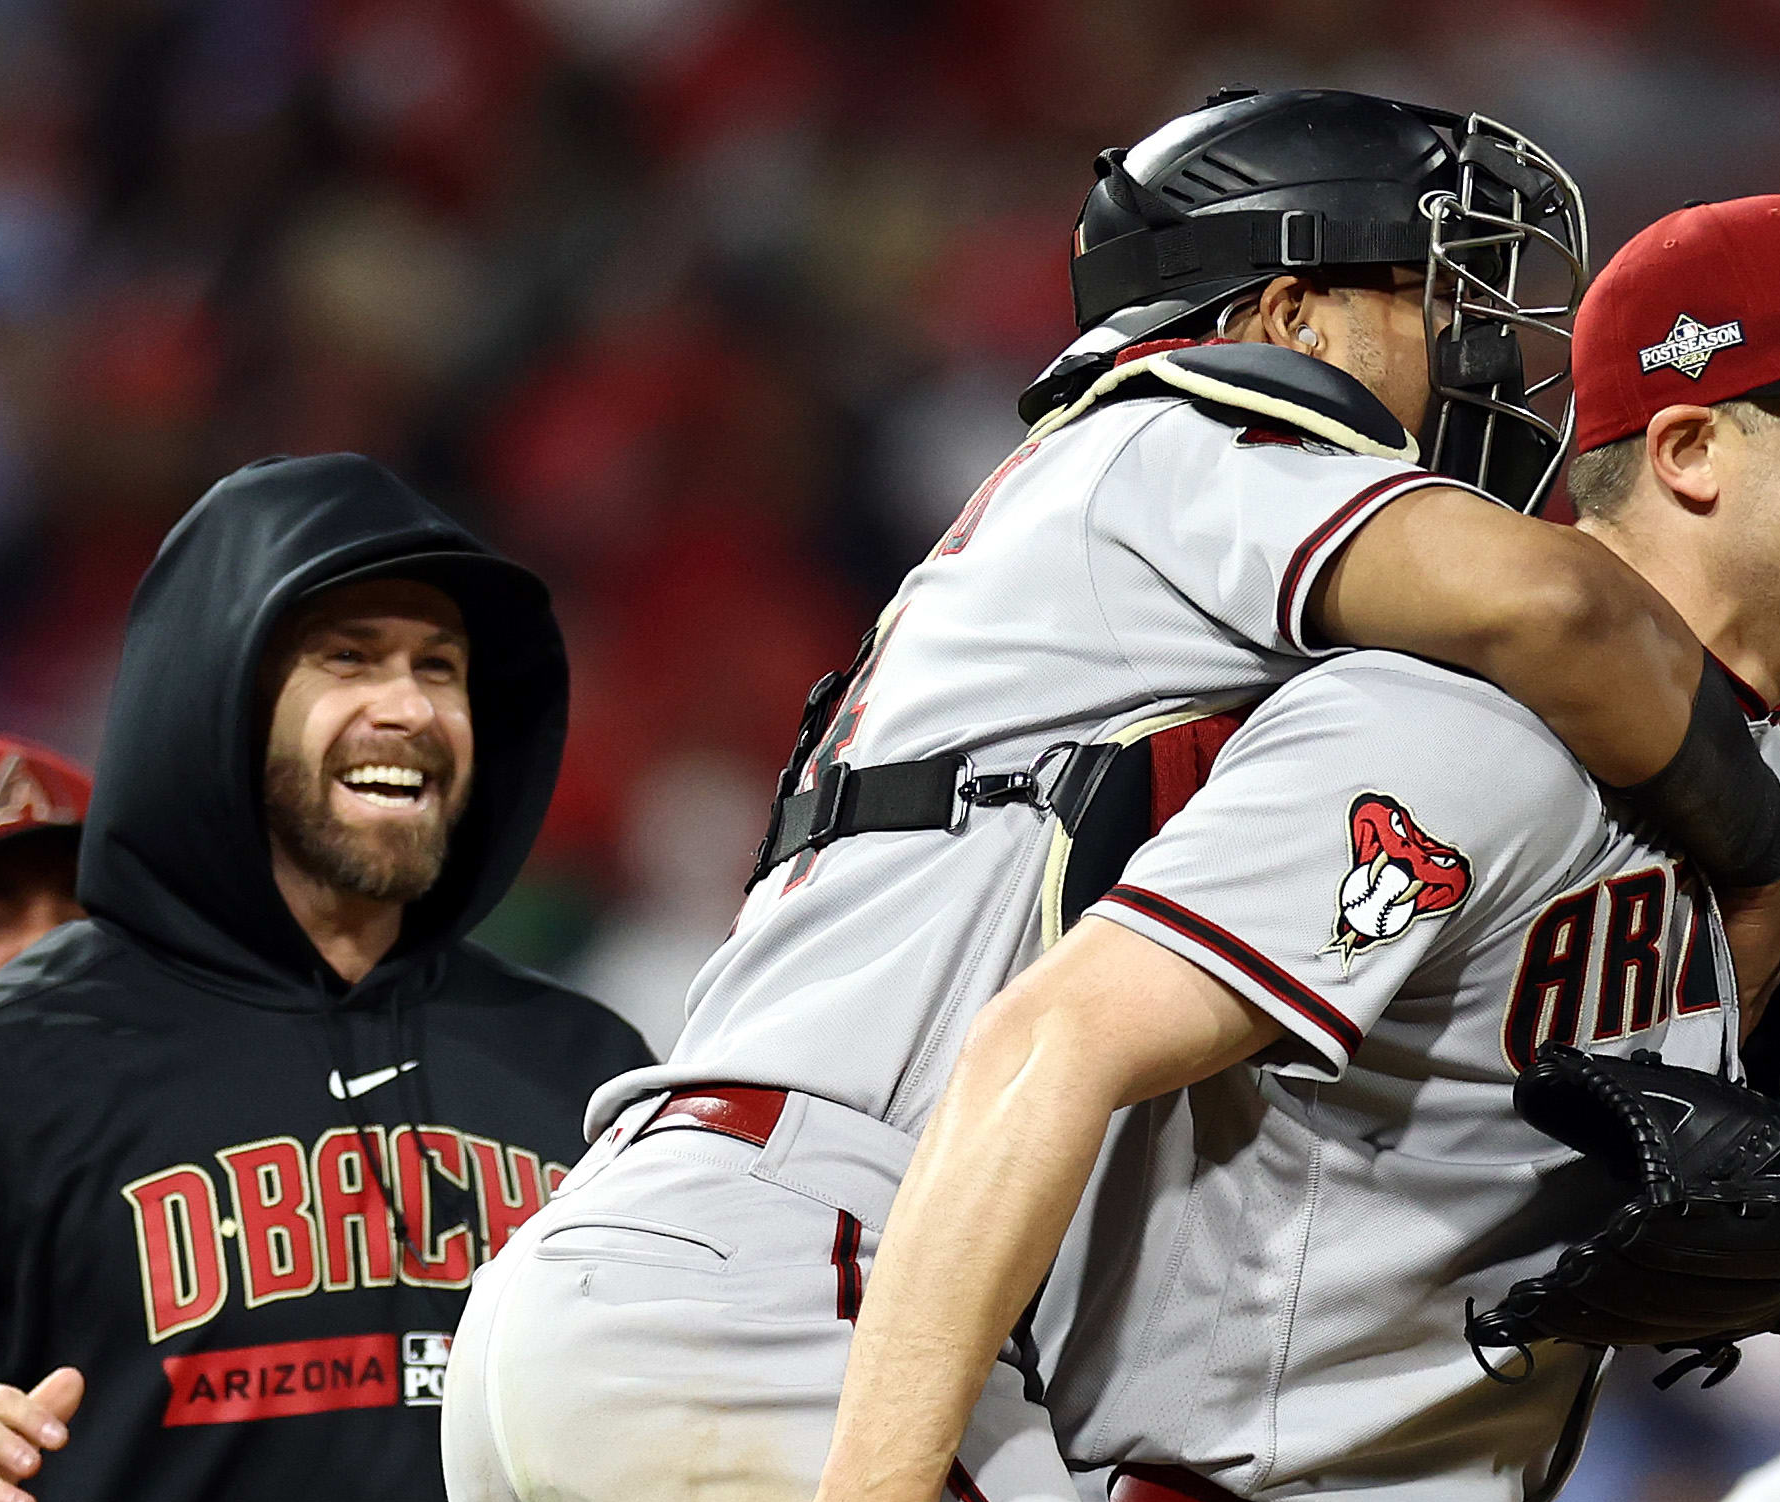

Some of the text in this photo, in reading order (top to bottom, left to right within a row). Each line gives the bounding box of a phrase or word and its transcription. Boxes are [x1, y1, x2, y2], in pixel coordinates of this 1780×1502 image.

[1640, 324, 1741, 368] POSTSEASON
[123, 1123, 569, 1344] D-BACK
[189, 1355, 386, 1404] ARIZONA
